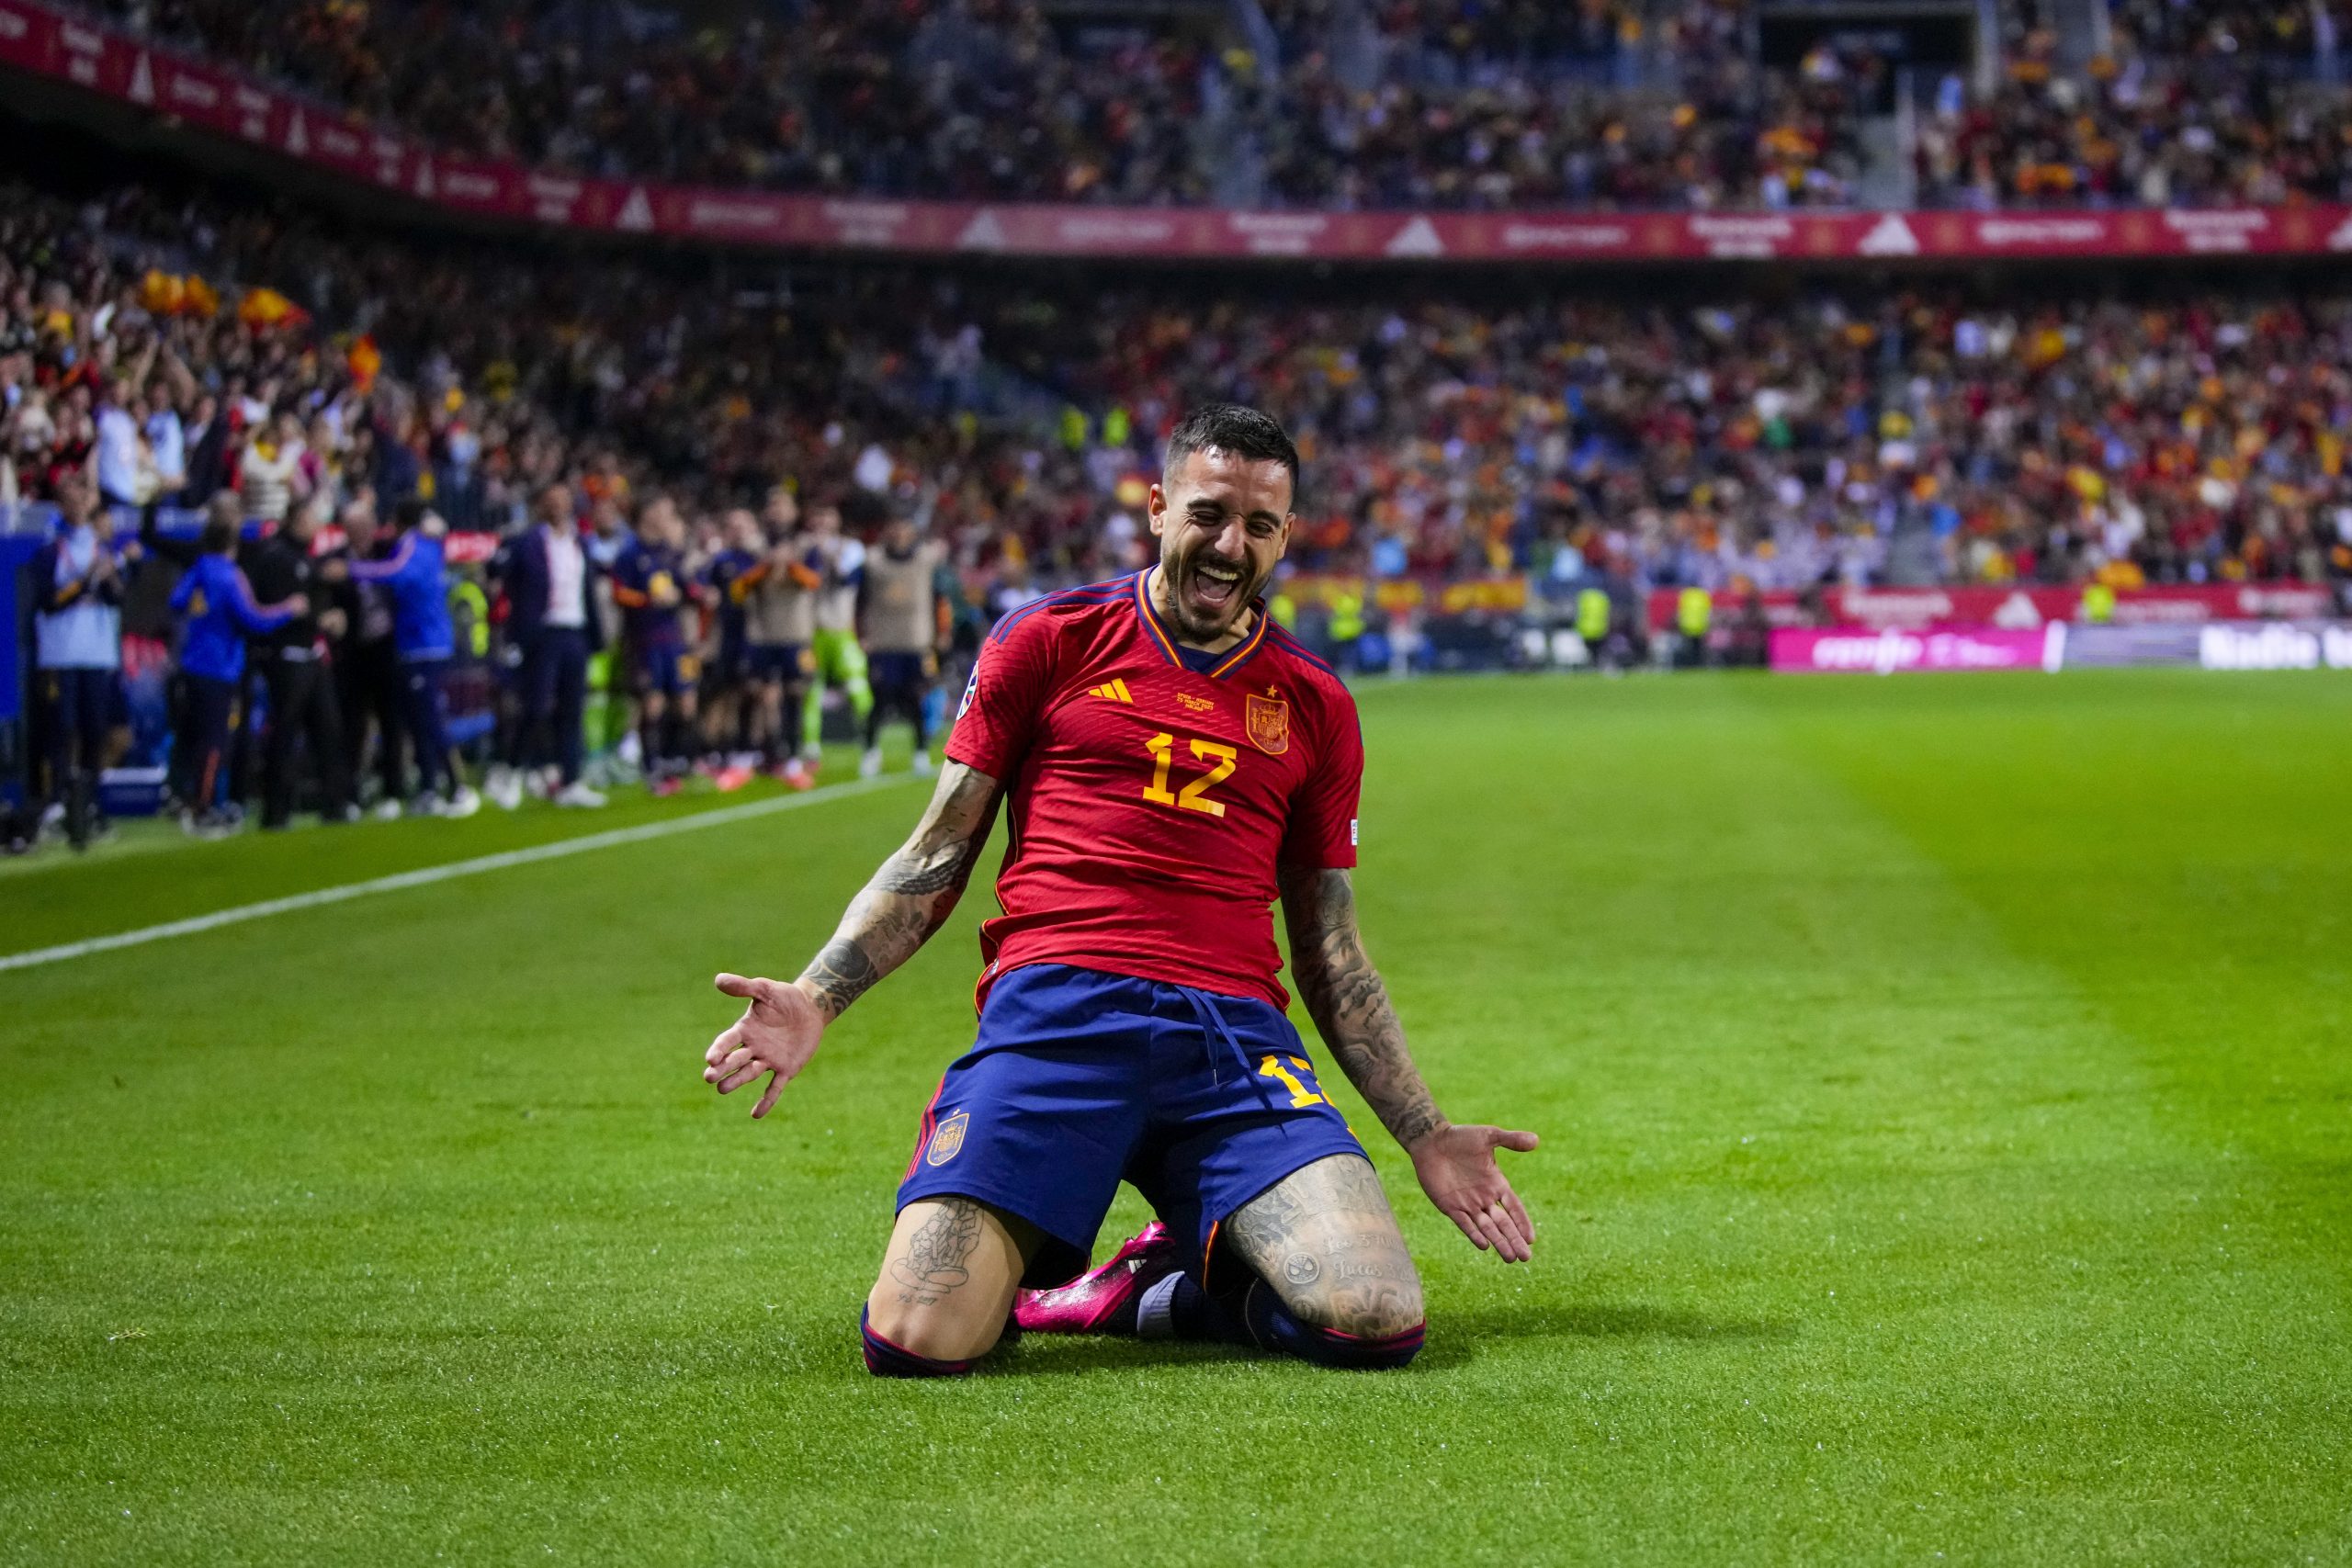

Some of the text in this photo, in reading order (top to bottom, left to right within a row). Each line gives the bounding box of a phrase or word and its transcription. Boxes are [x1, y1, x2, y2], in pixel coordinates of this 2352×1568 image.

[1143, 732, 1237, 818] 12
[1259, 1055, 1335, 1109] 1
[1333, 1260, 1383, 1281] Lucas
